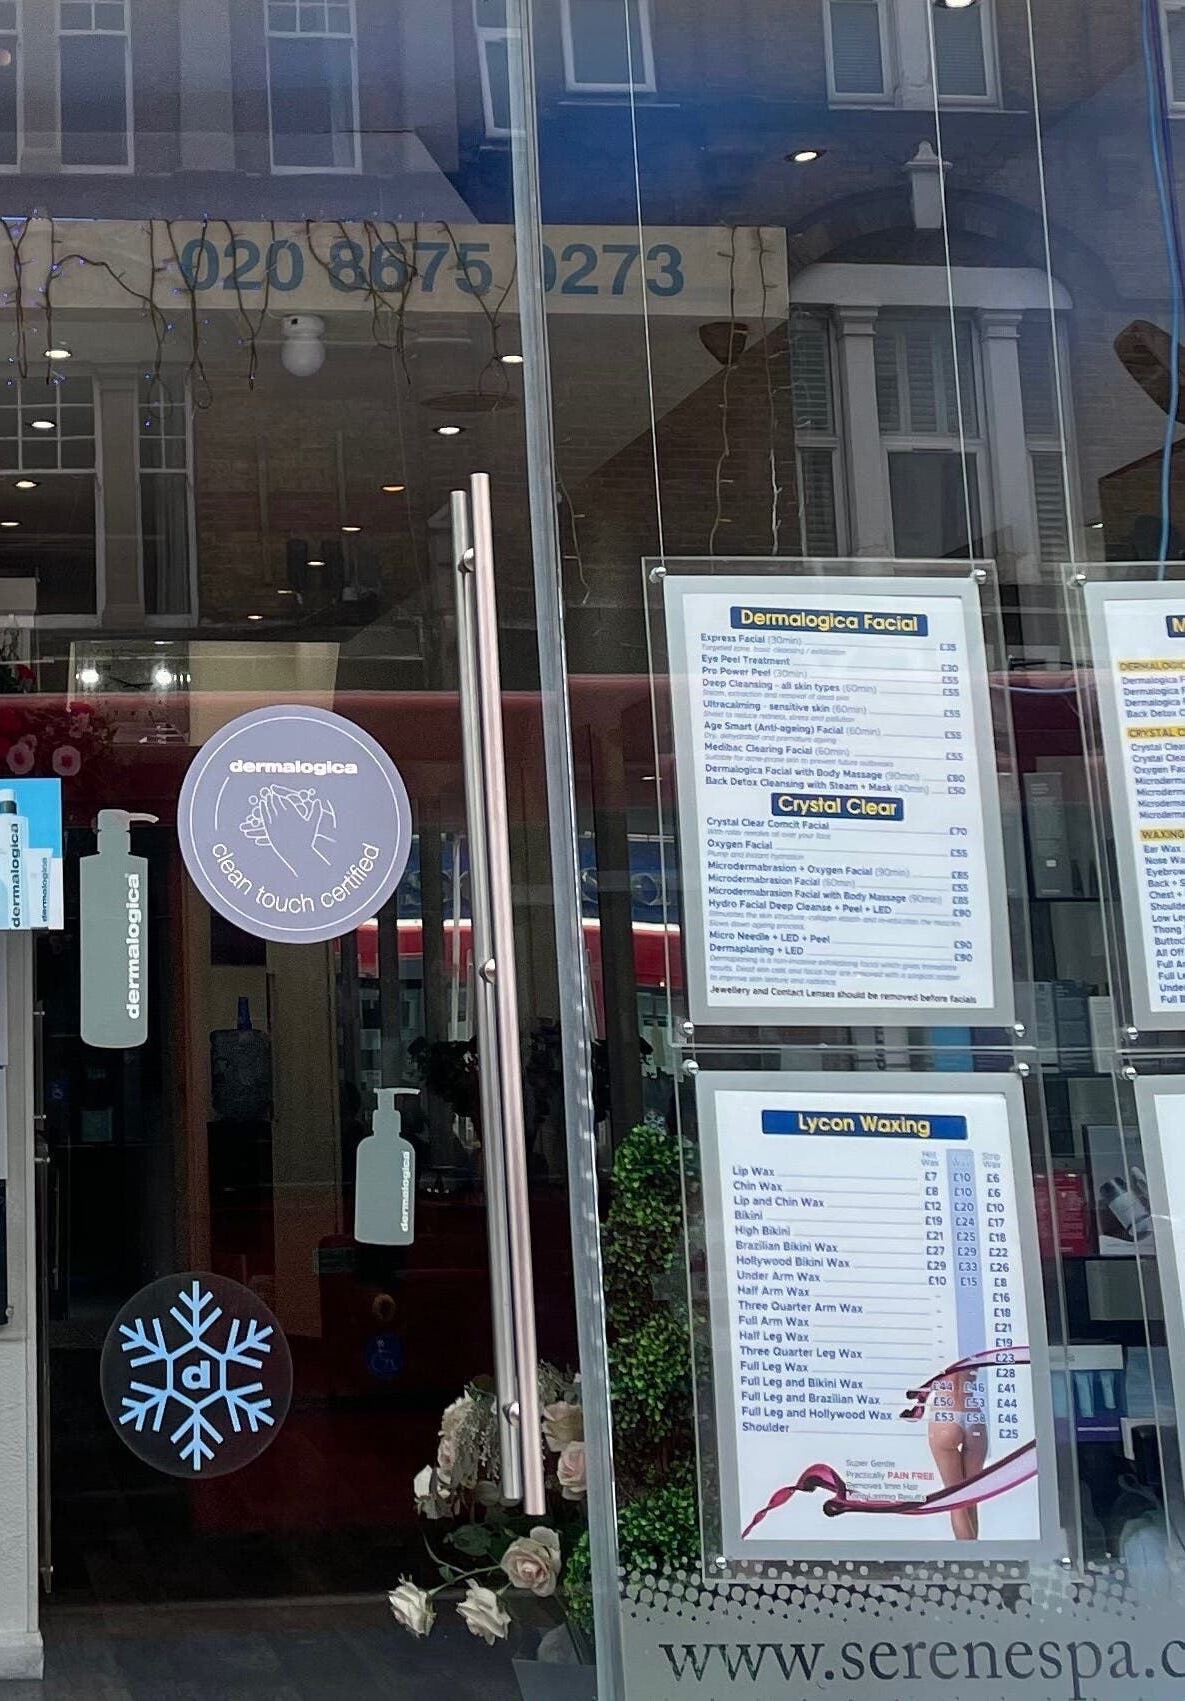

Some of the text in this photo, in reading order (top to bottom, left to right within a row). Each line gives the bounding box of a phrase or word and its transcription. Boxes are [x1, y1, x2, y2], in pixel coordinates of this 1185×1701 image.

[182, 241, 304, 292] 020
[328, 241, 494, 294] 8675
[741, 608, 919, 633] Dermalogica Facial
[701, 633, 737, 645] Express
[738, 634, 766, 644] Facial
[702, 655, 720, 664] Eye
[721, 656, 741, 664] Peel
[743, 656, 791, 666] Treatment
[1124, 688, 1180, 697] Dermalogica
[1127, 709, 1176, 718] Back Detox
[704, 722, 844, 735] Age Smart (Anti-ageing) Facial
[1129, 729, 1171, 738] CRYSTAL
[1132, 754, 1164, 764] Crystal
[230, 760, 358, 776] dermalogica
[705, 764, 883, 781] Dermalogica Facial with Body Massage
[778, 795, 897, 816] Crystal Clear
[707, 817, 739, 828] Crystal
[741, 818, 765, 827] Clear
[802, 821, 830, 830] Facial
[1144, 845, 1182, 853] Ear Wax
[10, 824, 21, 928] dermalogica
[211, 842, 380, 913] clean touch certified
[41, 858, 49, 922] dermalogica
[709, 931, 735, 940] Micro
[737, 932, 770, 942] Needle
[780, 933, 800, 943] LED
[810, 934, 831, 944] Peel
[1153, 926, 1182, 935] Thong
[126, 873, 142, 1019] dermalogica
[1156, 948, 1184, 957] All Off
[710, 986, 977, 1004] Jewellery and Contact Lenses should be removed before facials
[798, 1113, 931, 1138] Lycon Waxing
[732, 1165, 1000, 1183] Lip Wax £7 £10 £6
[401, 1151, 411, 1232] dermalogica
[733, 1181, 1001, 1198] Chin Wax £8 £10 £6
[733, 1196, 1005, 1213] Lip and Chin Wax £12 £20 £10
[735, 1240, 1009, 1257] Brazilian Bikini Wax £27 £29 £22
[736, 1255, 1010, 1273] Hollywood Bikini Wax £29 £33 £26
[181, 1360, 211, 1390] d
[741, 1406, 761, 1417] Full
[763, 1407, 784, 1419] Leg
[786, 1407, 806, 1418] and
[809, 1408, 865, 1421] Hollywood
[868, 1410, 893, 1420] Wax
[935, 1412, 955, 1422] £53
[998, 1414, 1018, 1424] £46
[846, 1471, 935, 1481] Practically PAIN FREE
